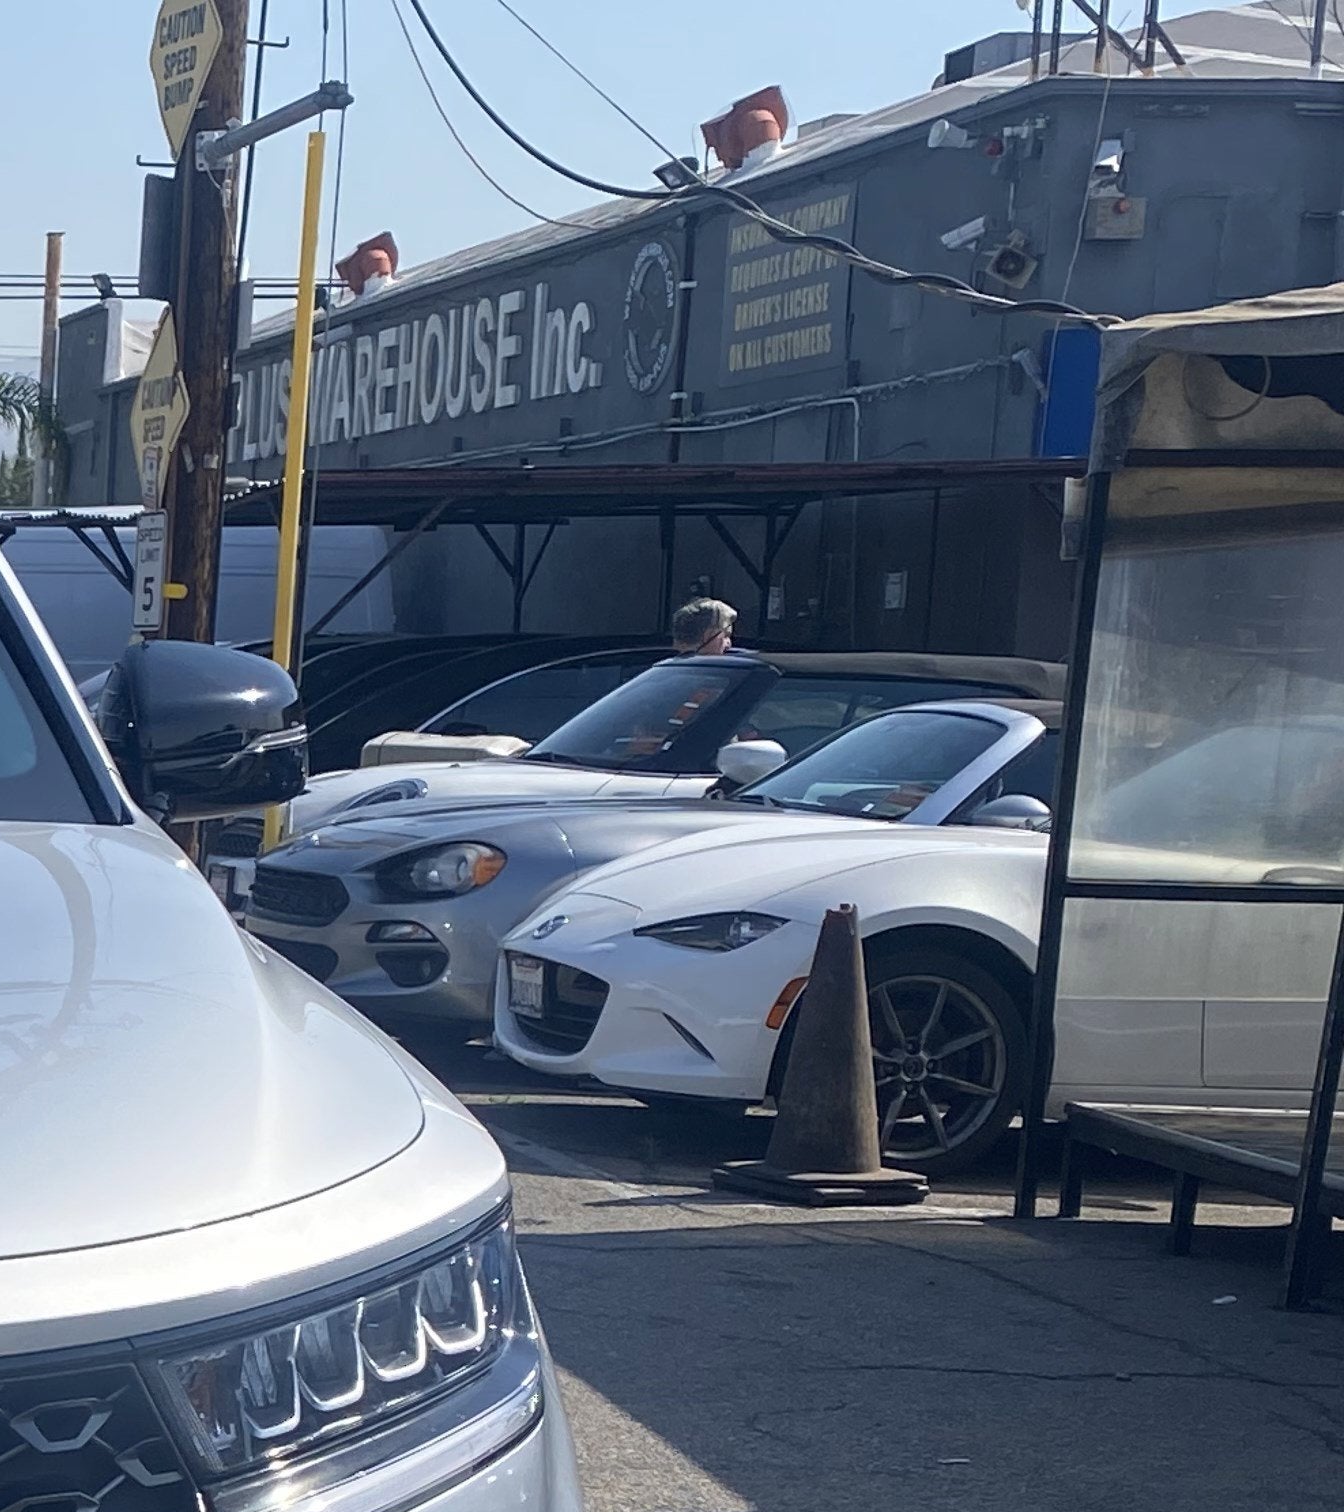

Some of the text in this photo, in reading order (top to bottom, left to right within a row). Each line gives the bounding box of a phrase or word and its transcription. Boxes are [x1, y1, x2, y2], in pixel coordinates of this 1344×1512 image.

[159, 3, 207, 48] CAUTION
[163, 45, 197, 81] SPEED
[164, 77, 194, 111] BUMP
[731, 194, 850, 254] INSURE COMPANY
[731, 254, 782, 293] REQUIRES
[783, 252, 791, 280] A
[734, 282, 830, 332] DRIVER'S LICENSE
[729, 323, 832, 372] ON ALL CUSTOMERS
[227, 358, 292, 464] PLUS
[308, 289, 525, 447] WAREHOUSE
[530, 282, 603, 400] Inc.
[138, 527, 164, 542] SPEED
[142, 576, 155, 611] 5
